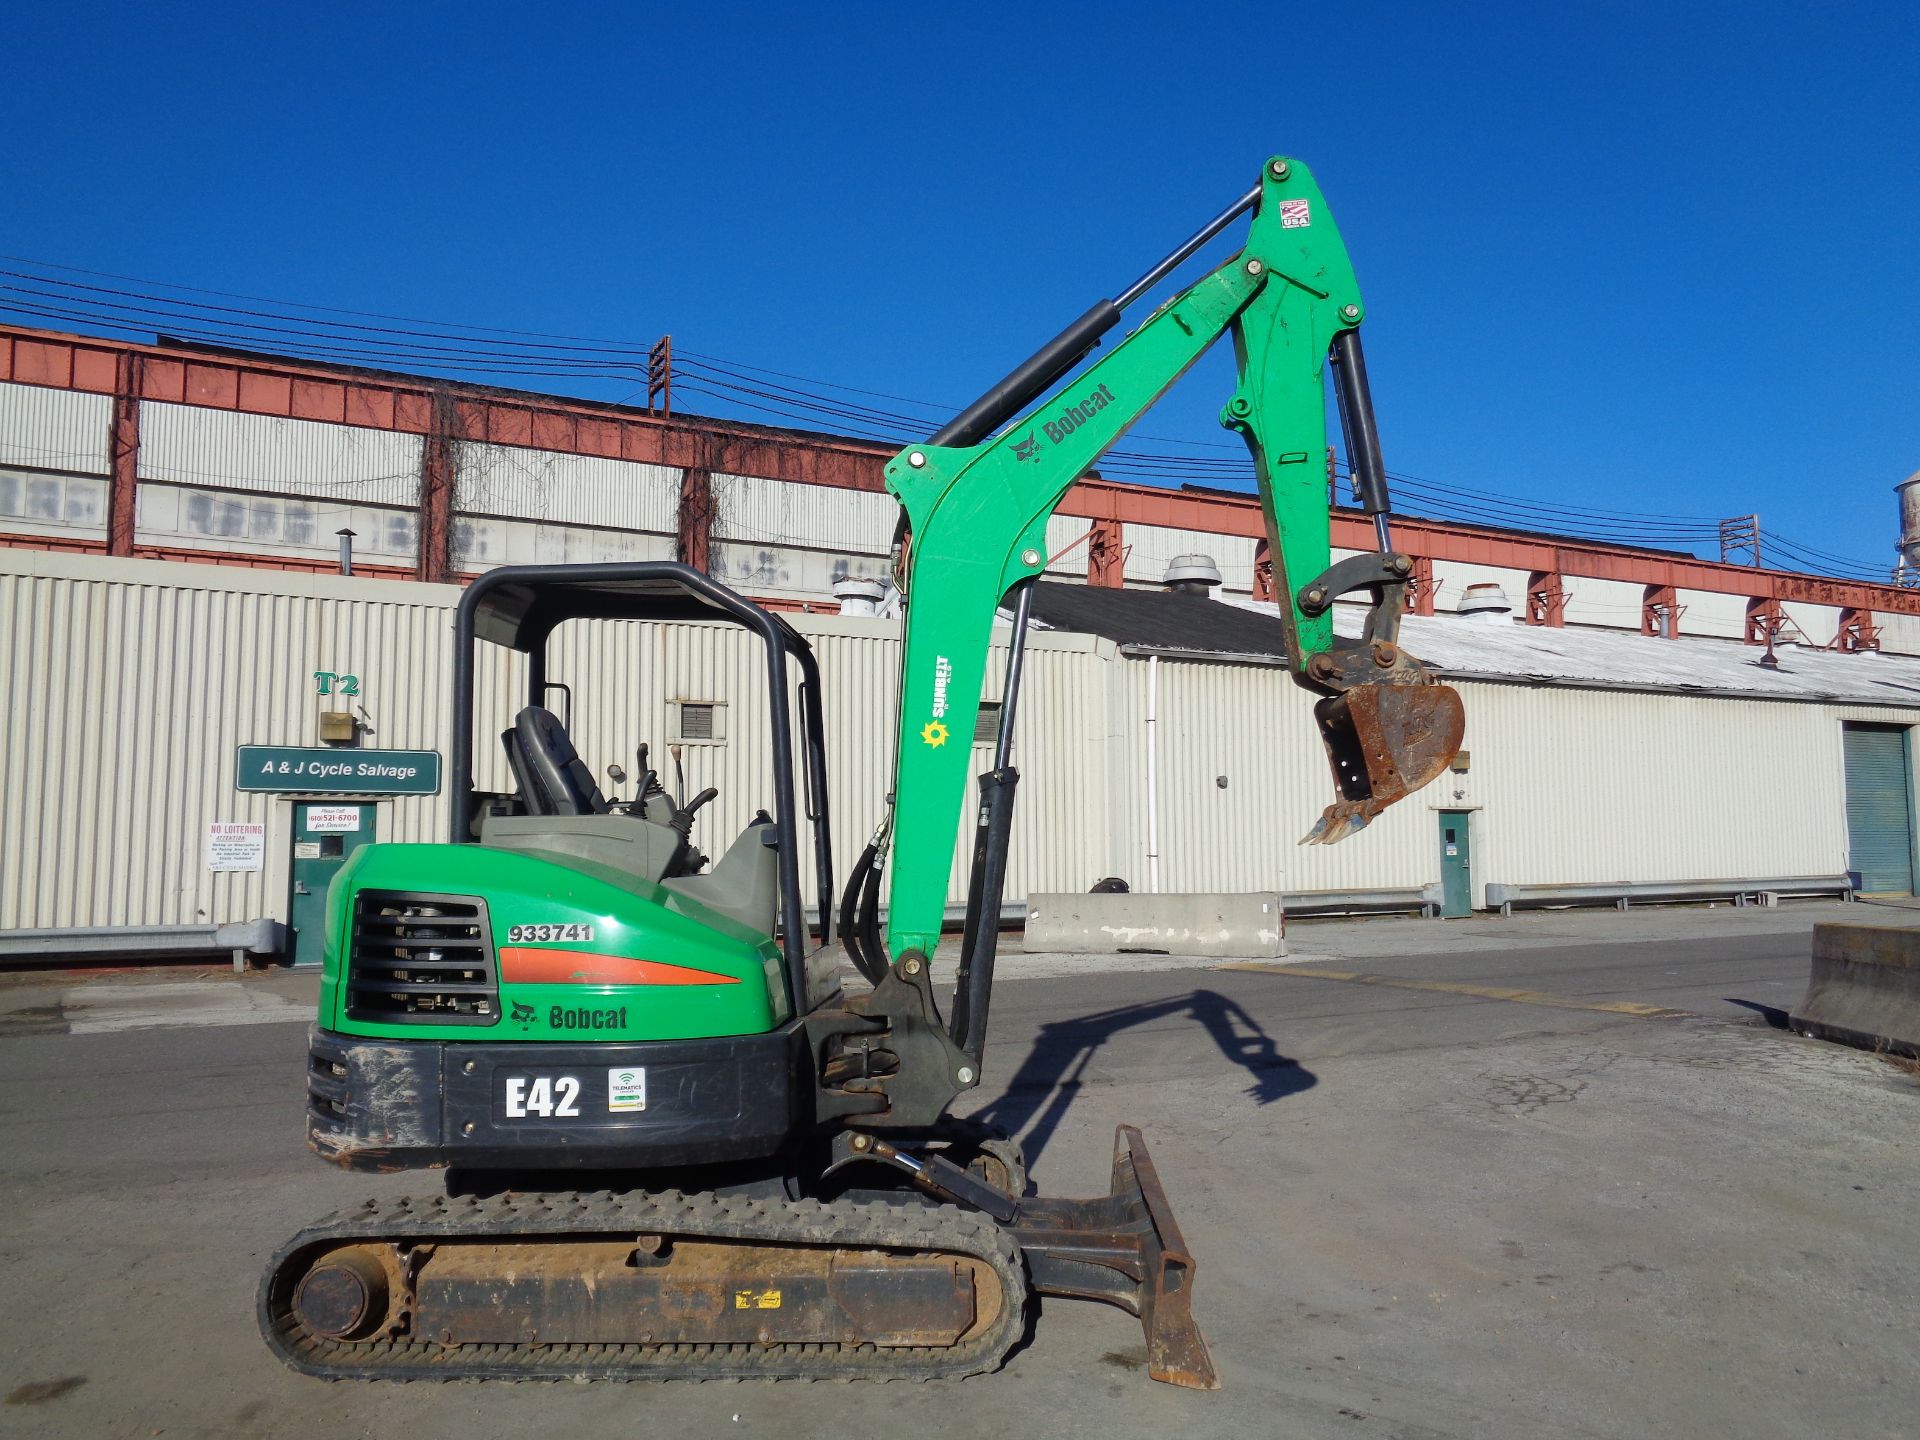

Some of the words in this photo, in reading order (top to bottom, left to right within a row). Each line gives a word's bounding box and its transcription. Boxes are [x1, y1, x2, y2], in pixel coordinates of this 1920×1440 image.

[1283, 217, 1308, 226] USA
[1042, 382, 1115, 445] Bobcat
[313, 671, 360, 697] T2
[933, 655, 948, 718] SUNBELT
[261, 760, 274, 773] A
[278, 762, 290, 774] &
[294, 762, 305, 774] J
[308, 761, 353, 778] Cycle
[357, 763, 417, 780] Salvage
[211, 825, 222, 834] NO
[224, 825, 263, 835] LOITERING
[509, 925, 592, 942] 933741
[549, 1006, 627, 1029] Bobcat
[505, 1077, 580, 1118] E42
